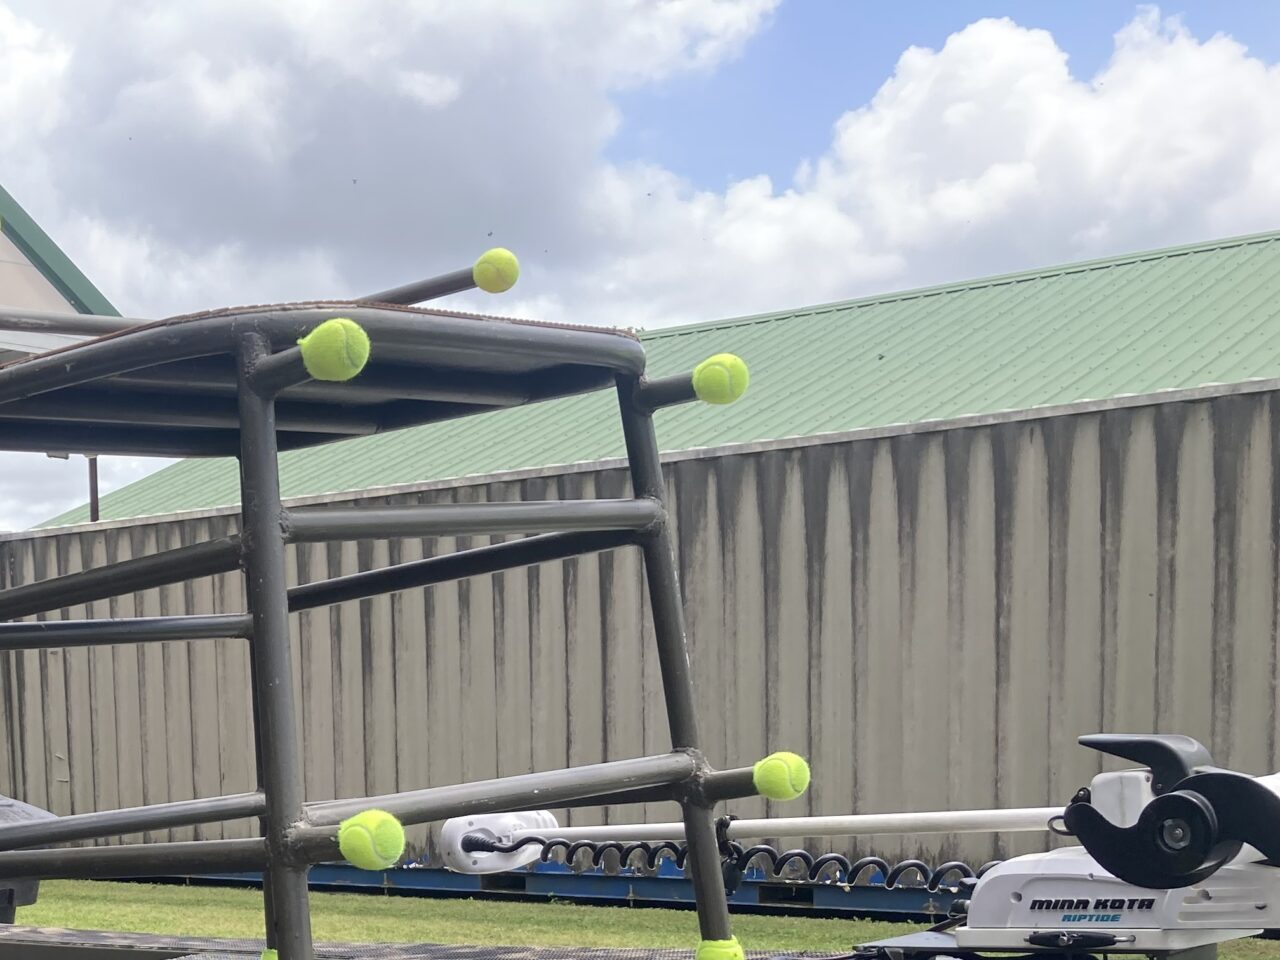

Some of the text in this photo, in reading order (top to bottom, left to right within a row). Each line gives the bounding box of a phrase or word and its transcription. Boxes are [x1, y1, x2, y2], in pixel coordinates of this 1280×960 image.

[1029, 898, 1156, 911] MINN KOTA
[1061, 913, 1122, 922] RIPTIDE
